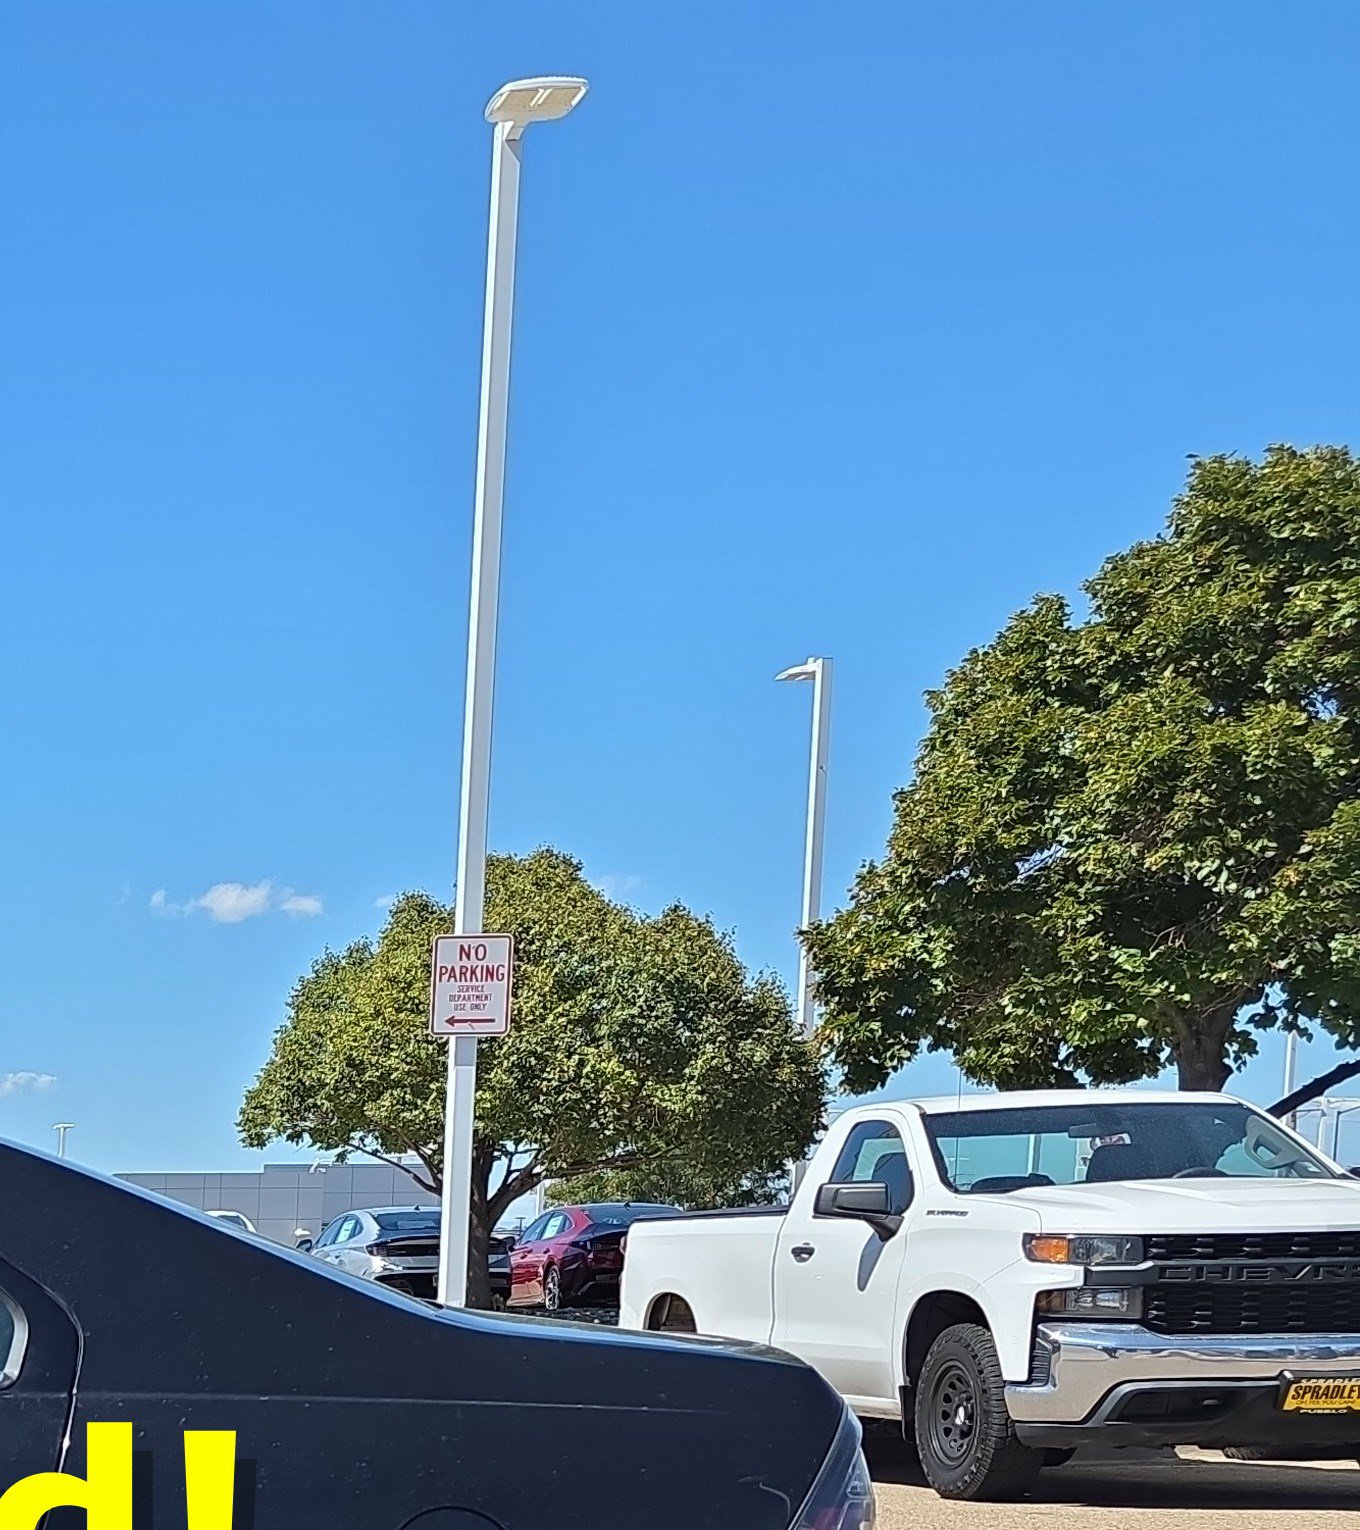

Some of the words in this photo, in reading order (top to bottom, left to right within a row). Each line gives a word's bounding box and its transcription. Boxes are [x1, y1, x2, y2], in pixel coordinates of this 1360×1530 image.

[458, 943, 487, 961] NO
[438, 964, 505, 983] PARKING
[456, 984, 485, 993] SERVICE
[448, 993, 492, 1002] DEPARTMENT
[453, 1003, 467, 1011] USE
